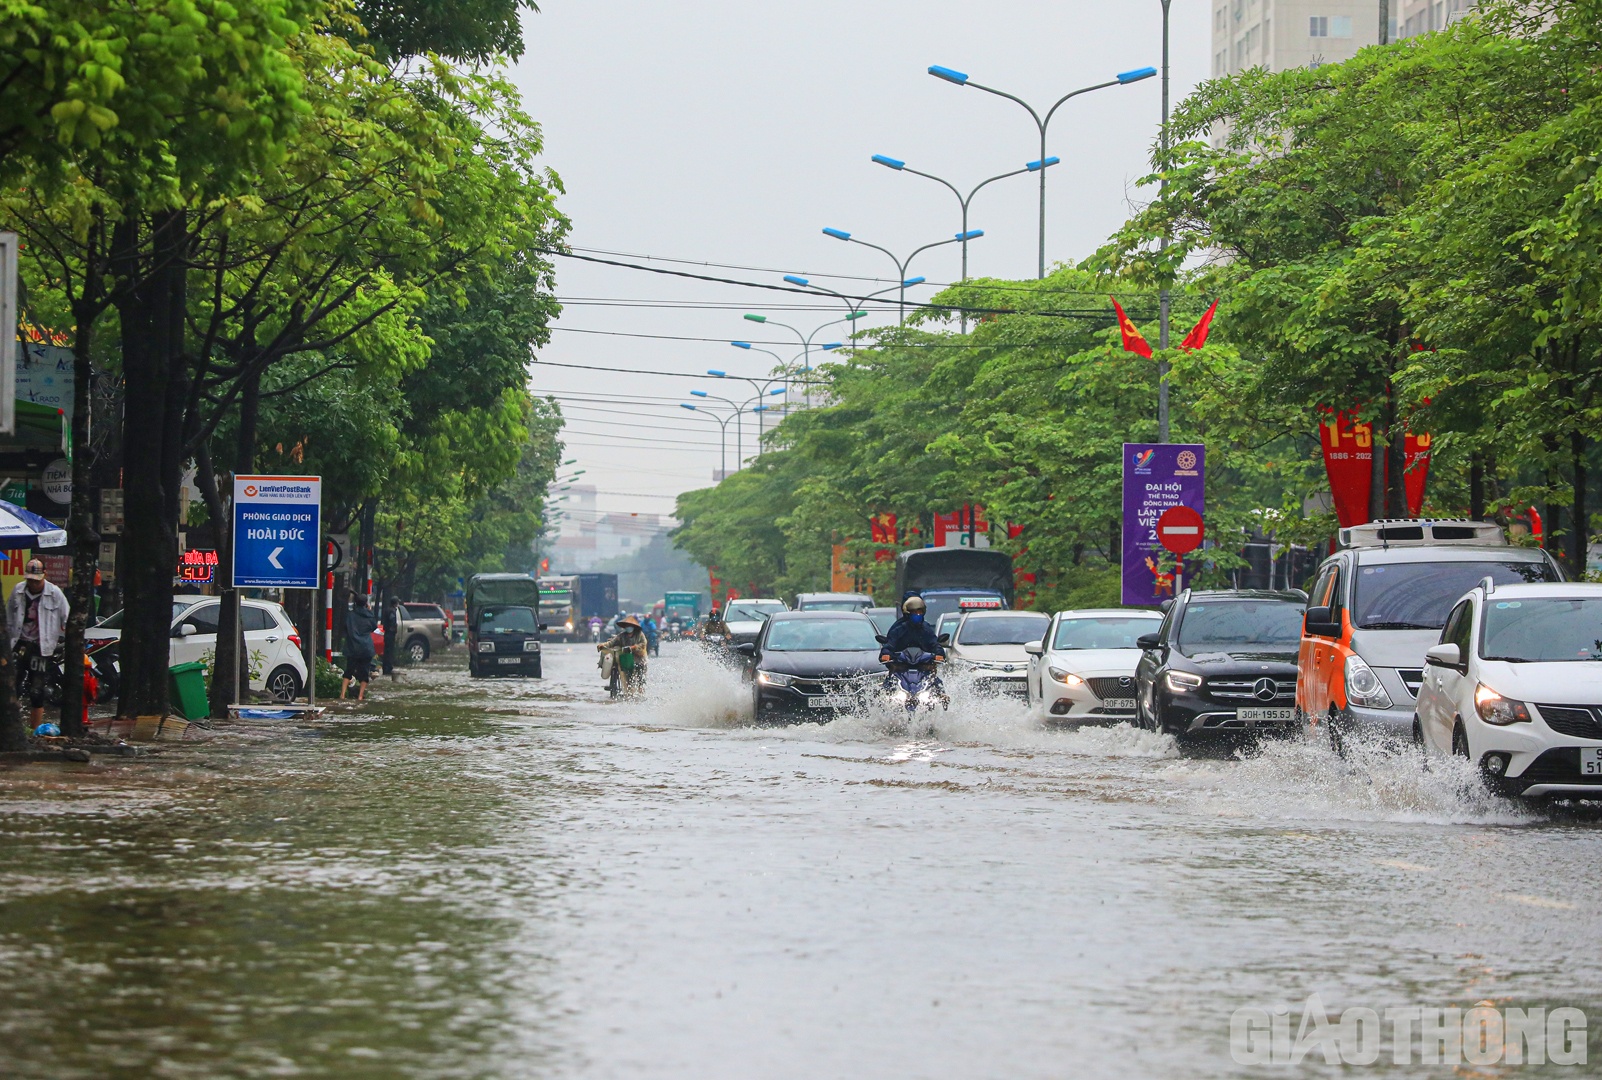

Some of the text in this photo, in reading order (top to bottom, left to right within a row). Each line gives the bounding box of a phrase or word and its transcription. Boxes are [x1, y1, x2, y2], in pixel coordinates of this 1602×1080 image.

[1329, 452, 1349, 460] 1886
[259, 485, 311, 493] LienVietPostBank
[1145, 481, 1182, 493] ĐẠI HỘI
[242, 512, 311, 523] PHÒNG GIAO DỊCH
[247, 527, 305, 541] HOÀI ĐỨC
